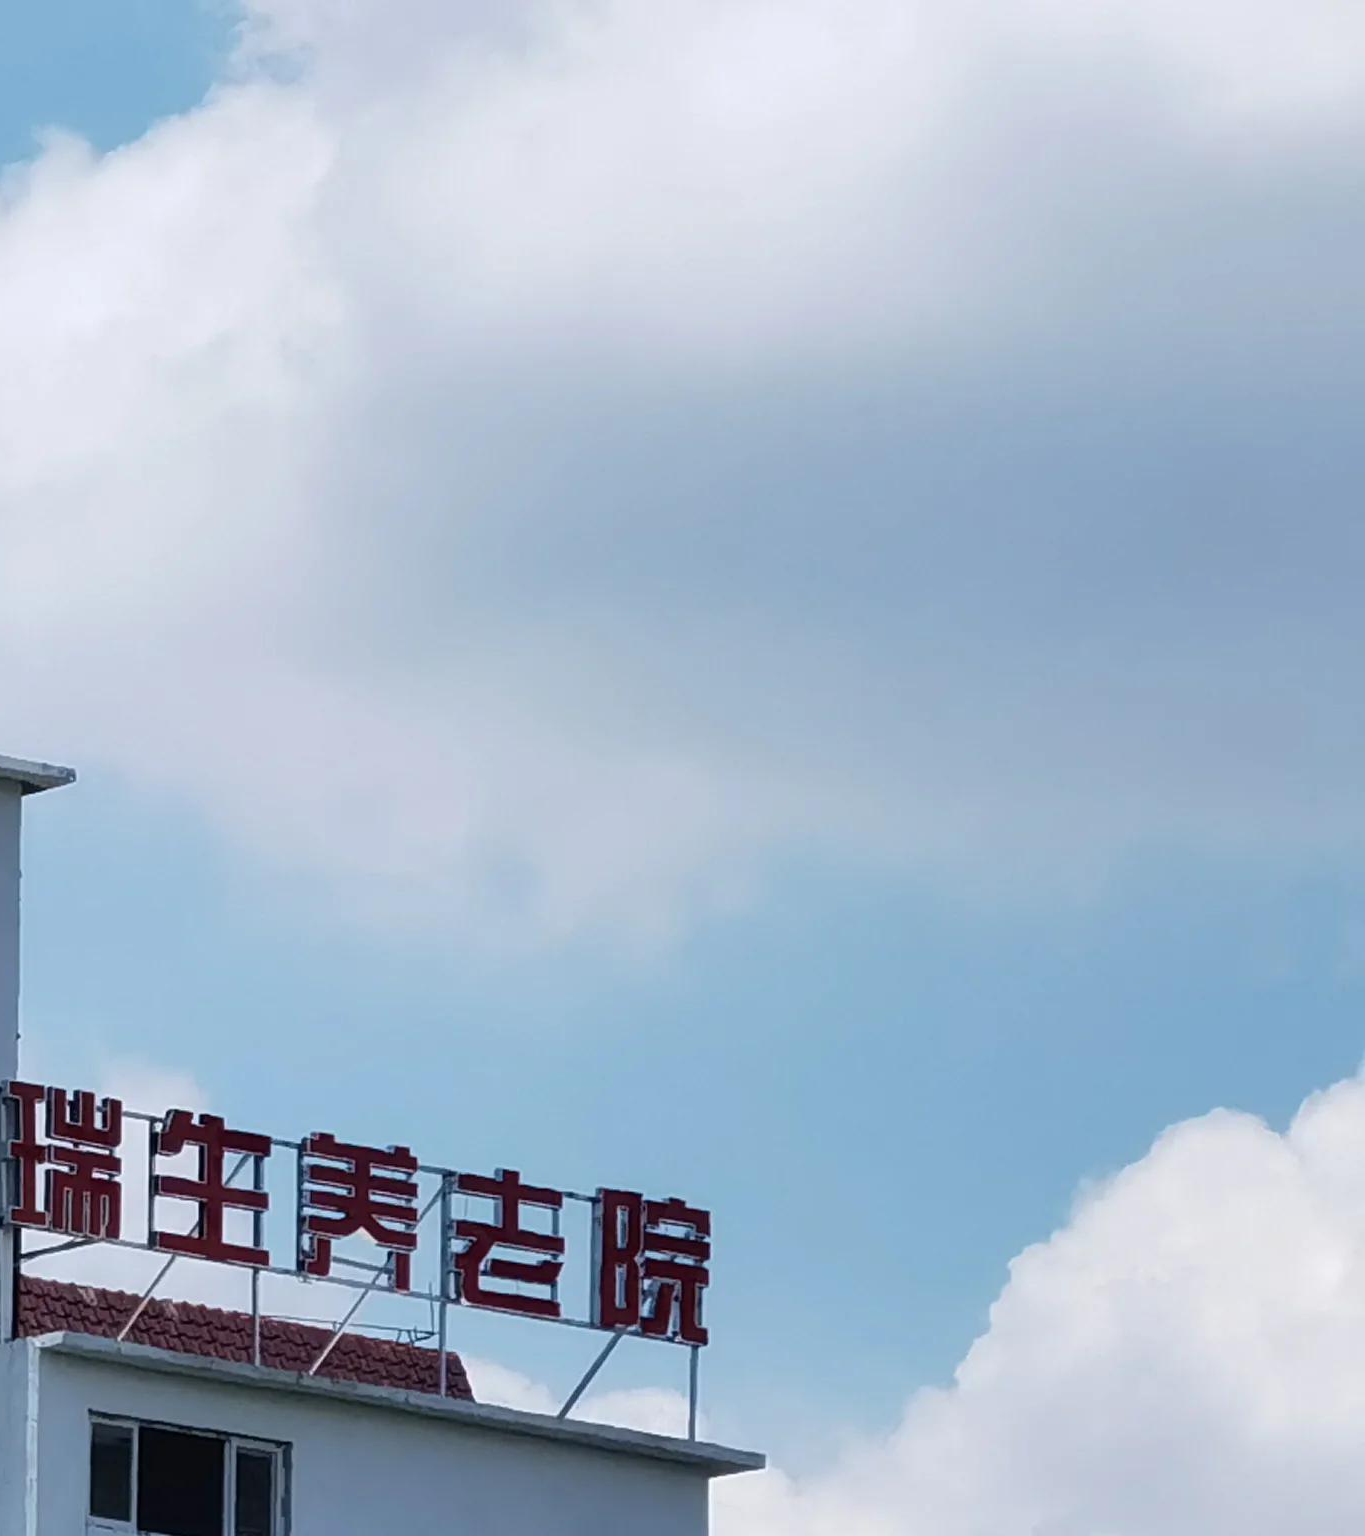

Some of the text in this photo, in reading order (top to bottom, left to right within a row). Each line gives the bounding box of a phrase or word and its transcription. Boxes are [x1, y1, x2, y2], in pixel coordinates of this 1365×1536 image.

[6, 1079, 711, 1347] 瑞生养老院
